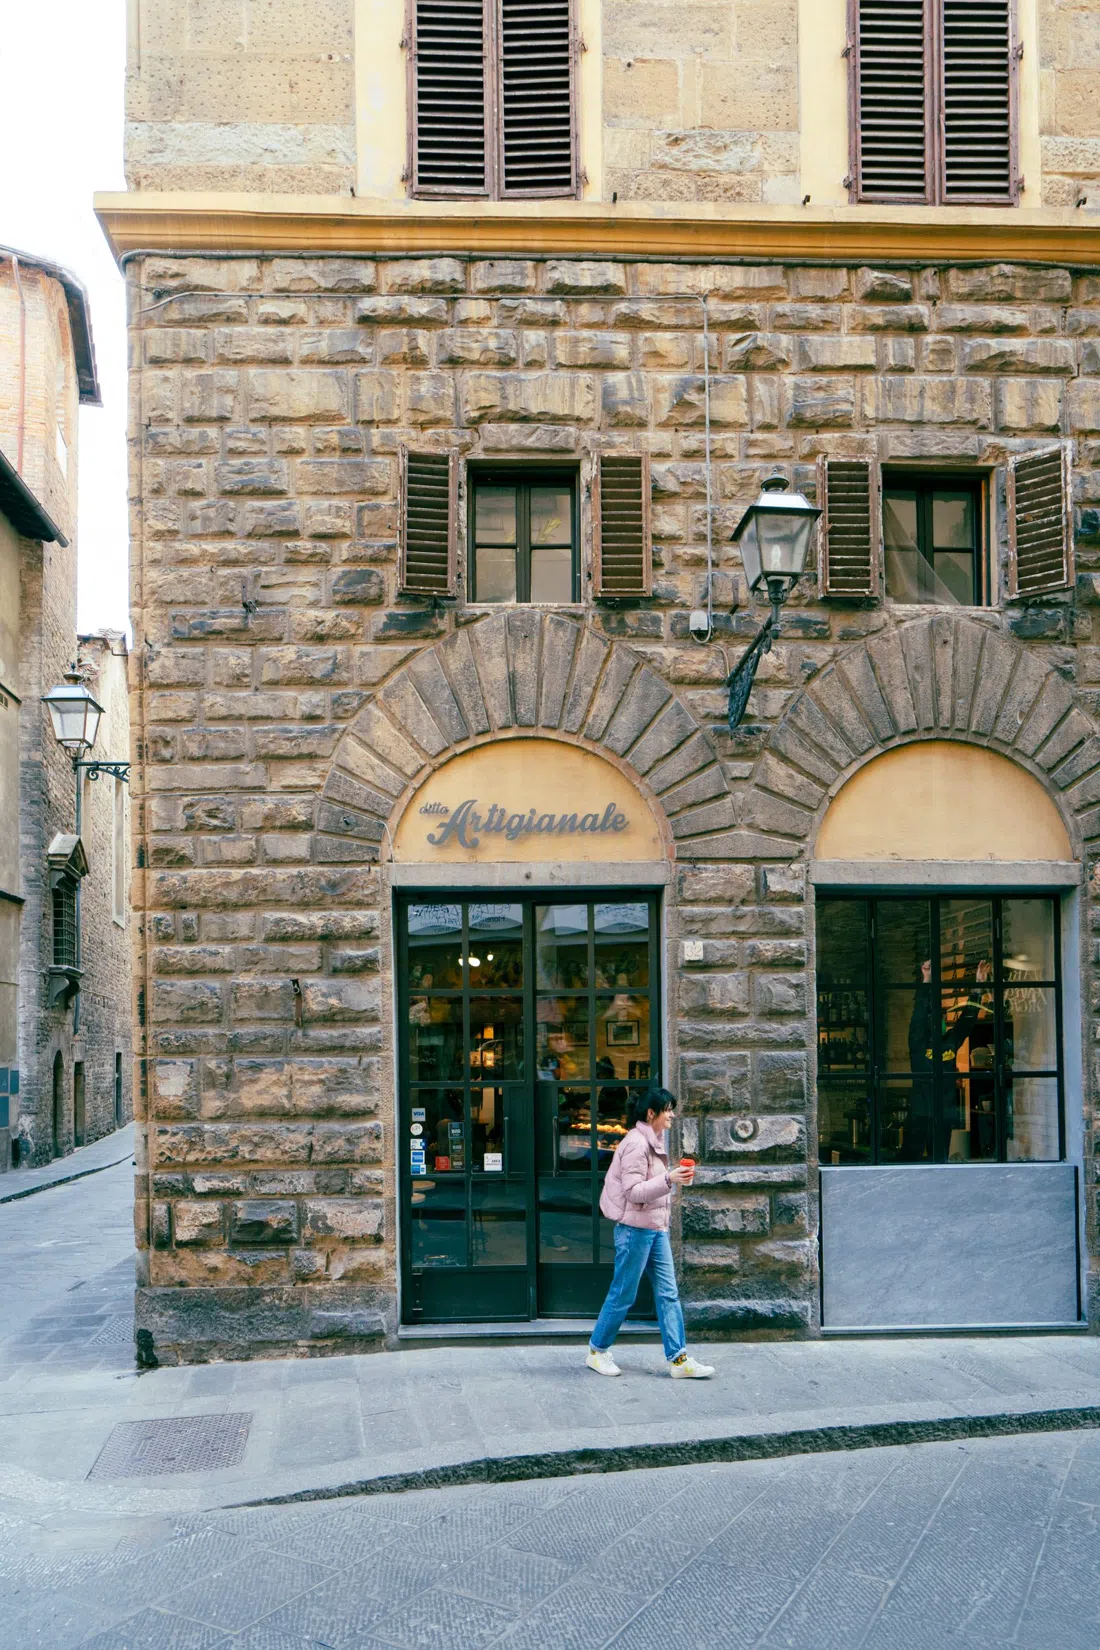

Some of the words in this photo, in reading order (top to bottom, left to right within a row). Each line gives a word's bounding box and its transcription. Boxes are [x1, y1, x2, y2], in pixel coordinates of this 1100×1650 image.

[419, 802, 449, 815] ditta
[427, 799, 630, 849] Artigianale
[686, 945, 702, 958] 32
